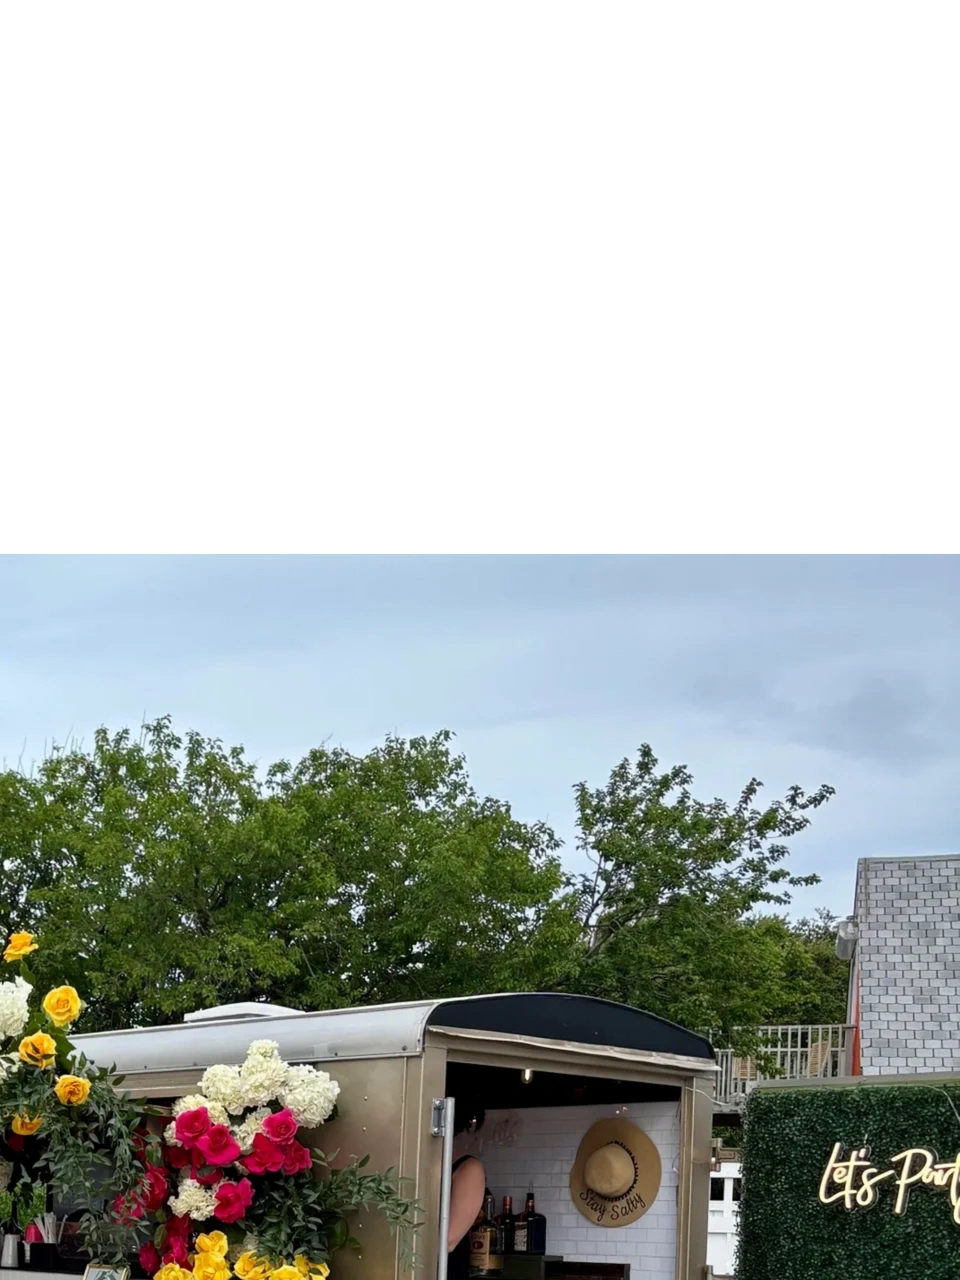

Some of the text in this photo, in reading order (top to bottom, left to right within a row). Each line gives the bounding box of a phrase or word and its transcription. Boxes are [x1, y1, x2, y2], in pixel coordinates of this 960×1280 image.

[820, 1142, 895, 1209] Let's
[579, 1188, 646, 1222] Stay Salty
